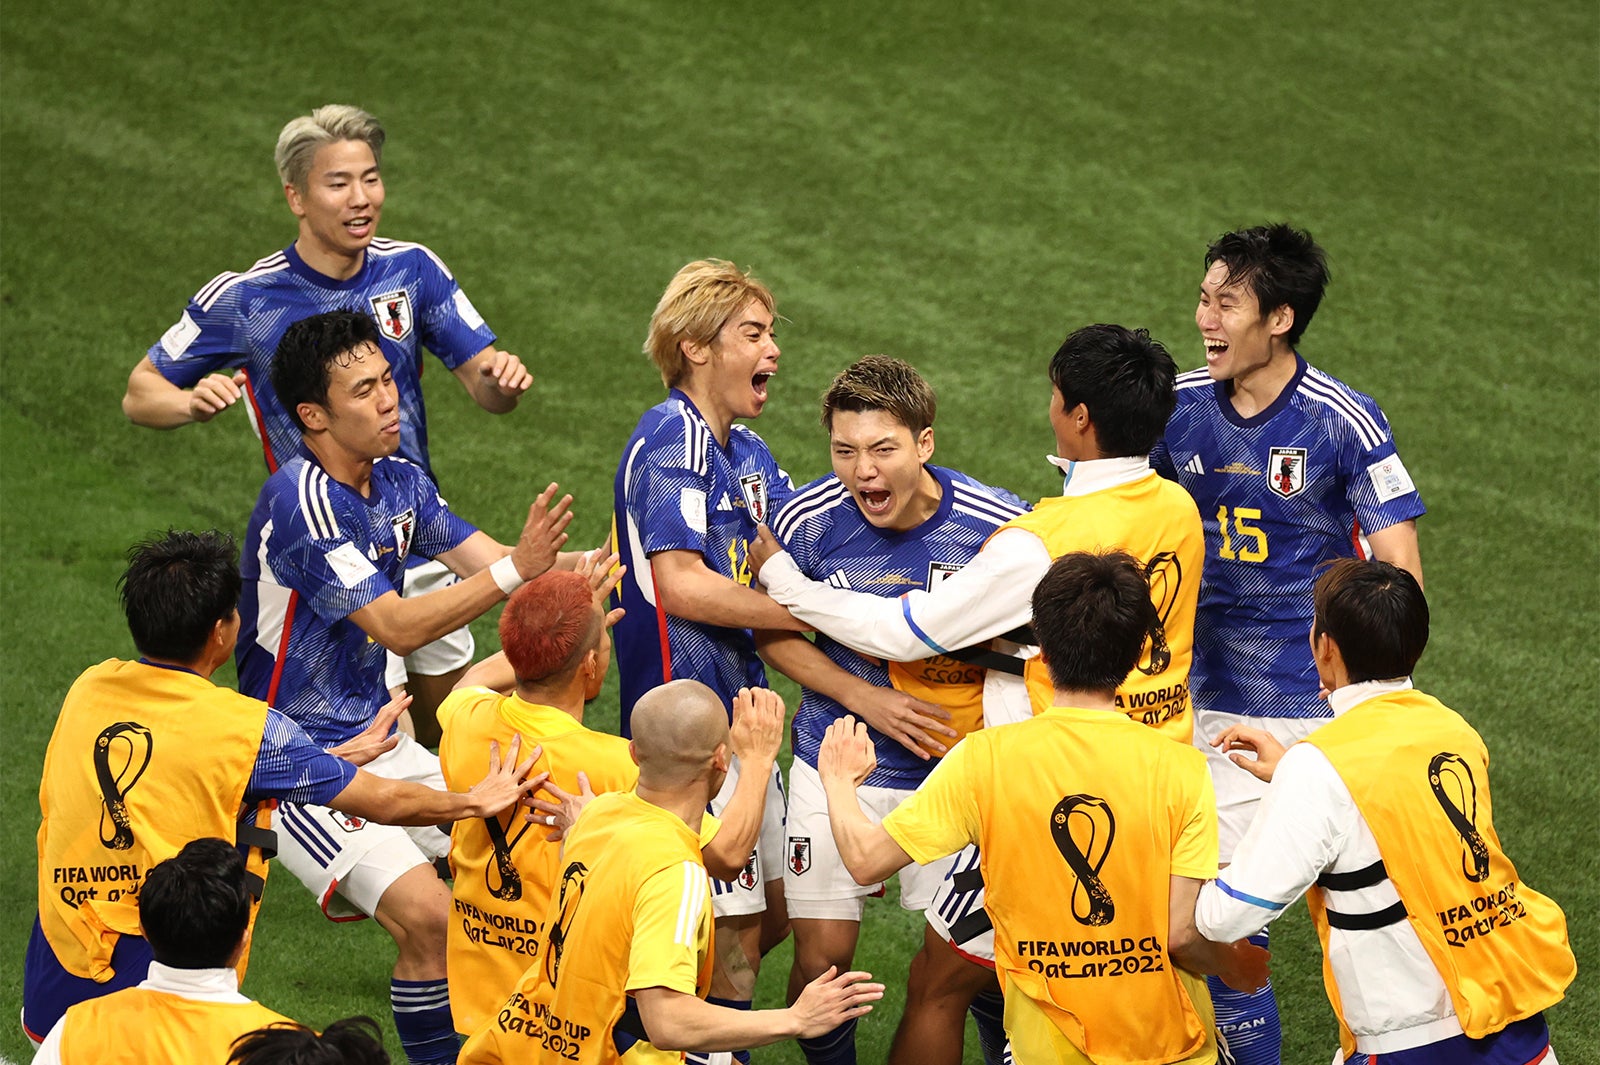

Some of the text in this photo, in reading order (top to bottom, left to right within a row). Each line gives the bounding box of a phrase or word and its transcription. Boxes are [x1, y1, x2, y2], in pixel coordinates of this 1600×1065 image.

[1216, 505, 1269, 563] 15
[1129, 684, 1183, 708] WORLD
[53, 865, 142, 883] FIFA WORL
[454, 898, 481, 921] FIFA
[480, 909, 537, 934] WORLD
[1436, 904, 1472, 926] IFA
[462, 918, 539, 957] Qatar20
[1018, 940, 1060, 957] FIFA
[1061, 938, 1135, 957] WORLD
